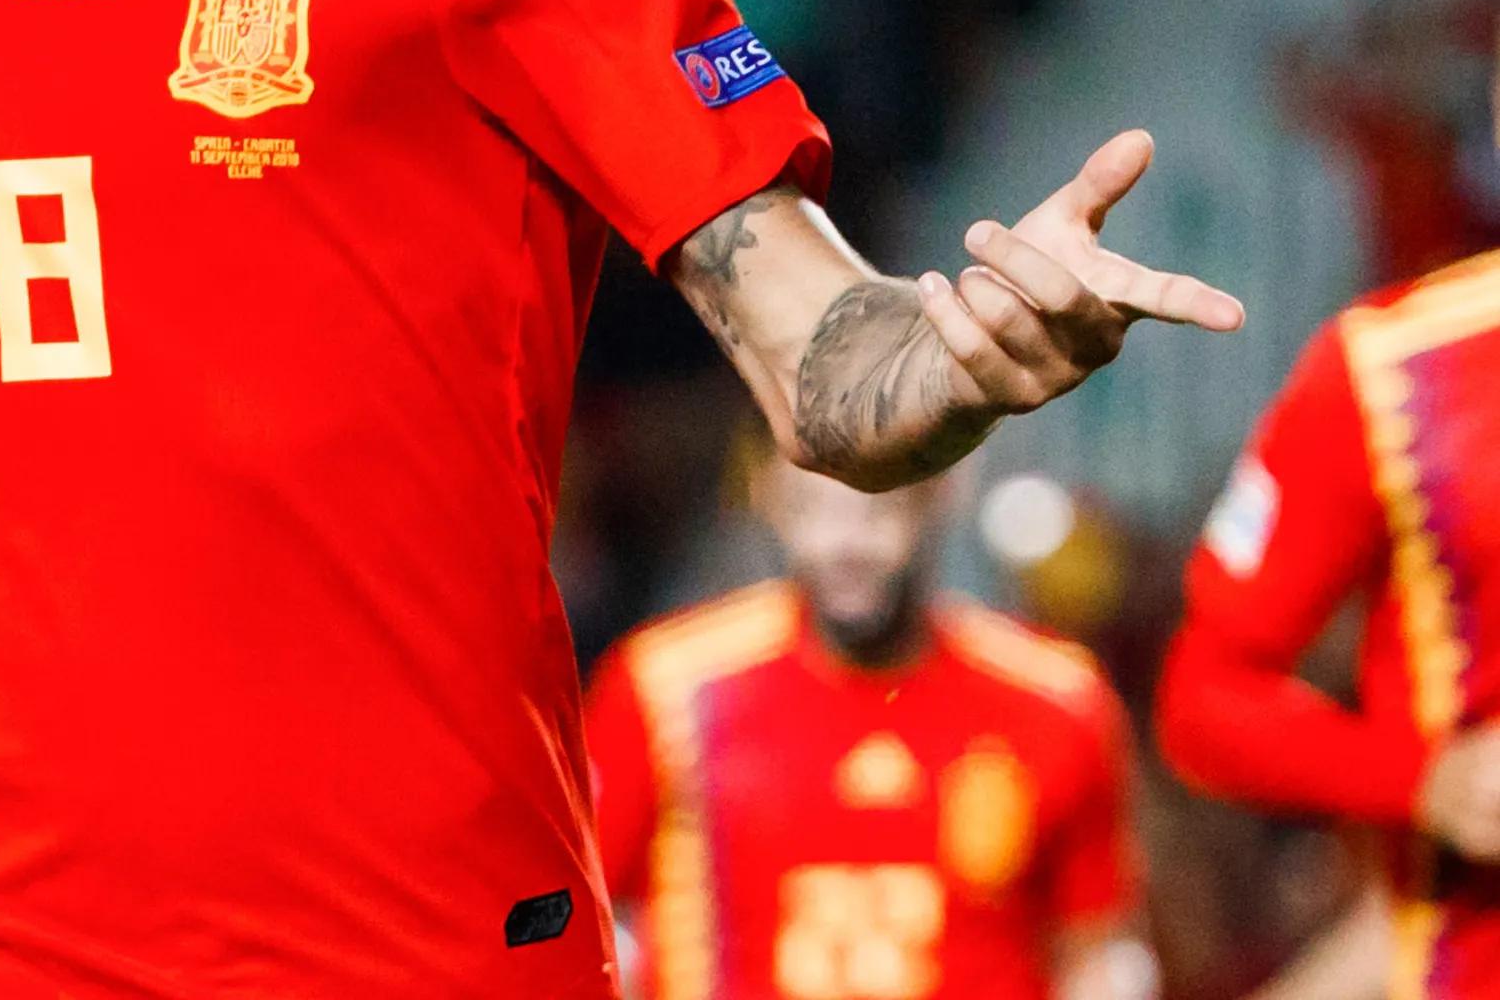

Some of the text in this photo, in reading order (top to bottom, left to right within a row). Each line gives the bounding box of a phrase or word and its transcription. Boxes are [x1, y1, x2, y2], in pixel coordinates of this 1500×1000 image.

[193, 135, 231, 151] SPAIN
[242, 137, 295, 153] CROATIA
[202, 150, 271, 166] SEPTEMBER
[227, 164, 263, 179] ELCHE
